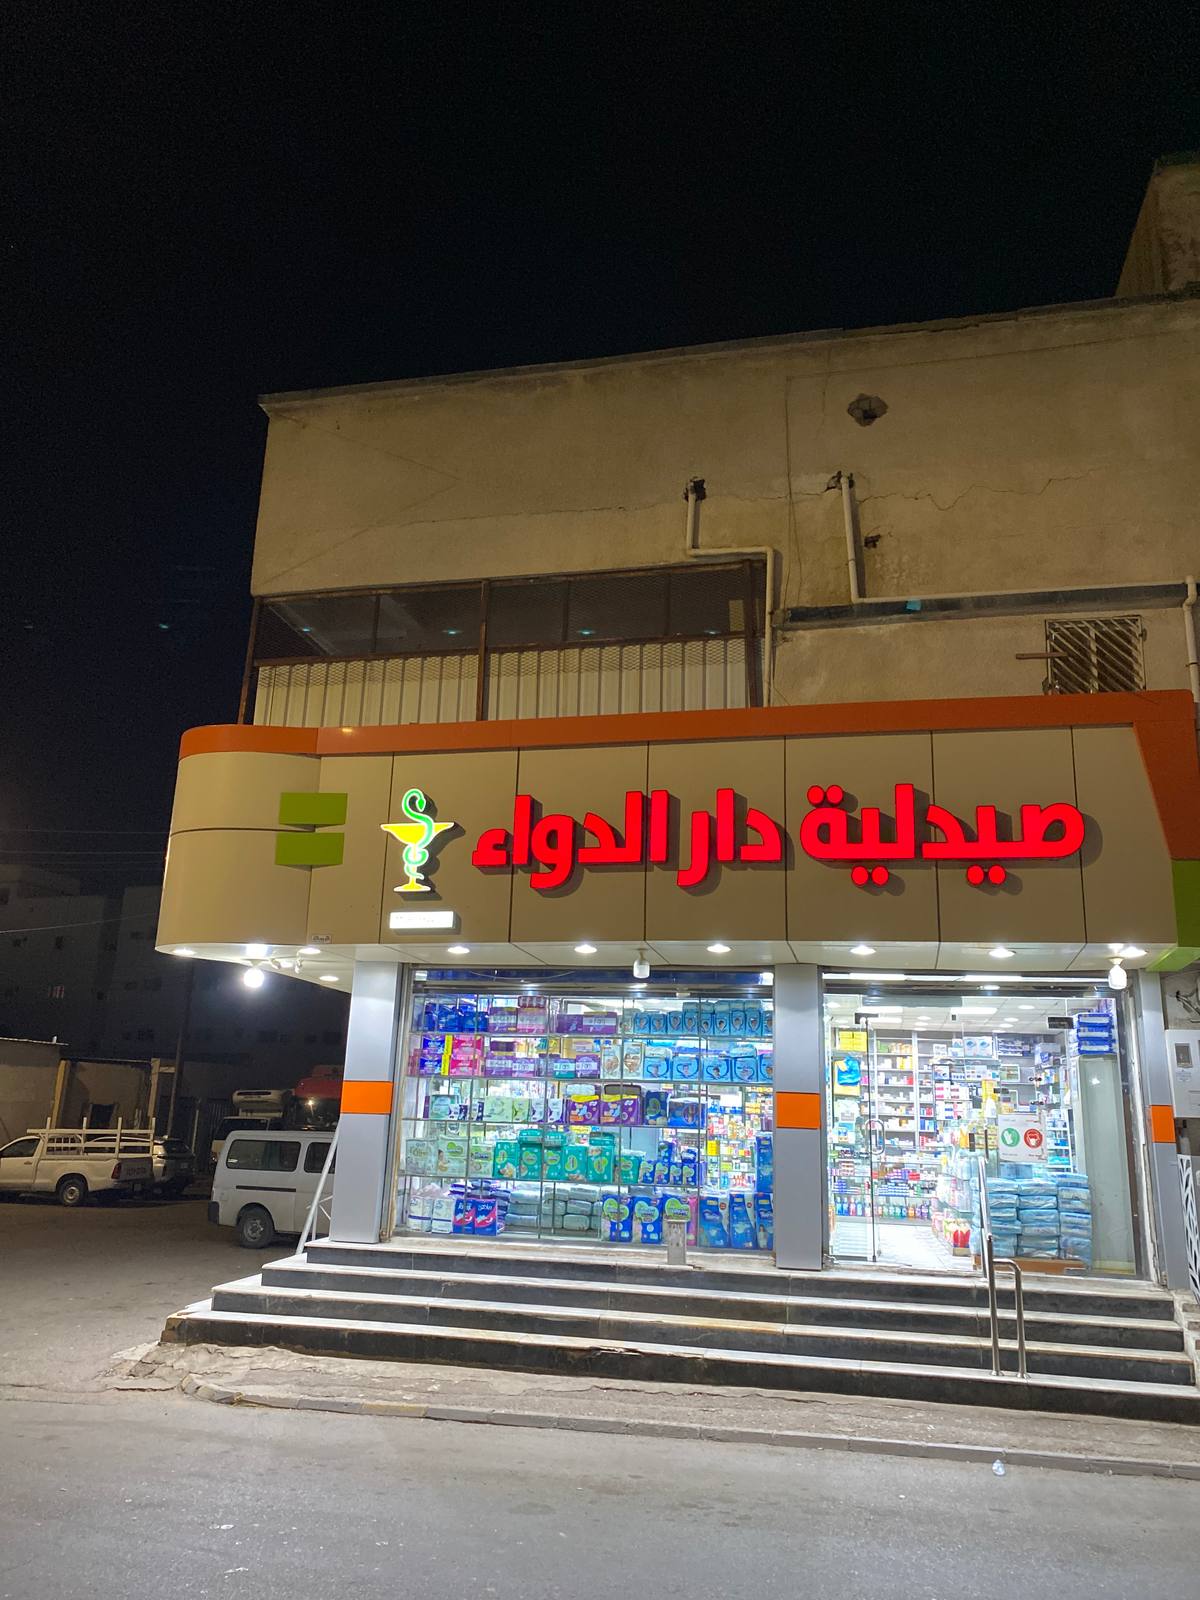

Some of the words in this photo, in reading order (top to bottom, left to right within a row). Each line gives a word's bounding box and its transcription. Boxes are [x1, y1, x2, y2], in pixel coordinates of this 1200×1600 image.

[471, 790, 669, 890] الدواء
[676, 788, 782, 887] دار
[800, 783, 1086, 886] صيدلية
